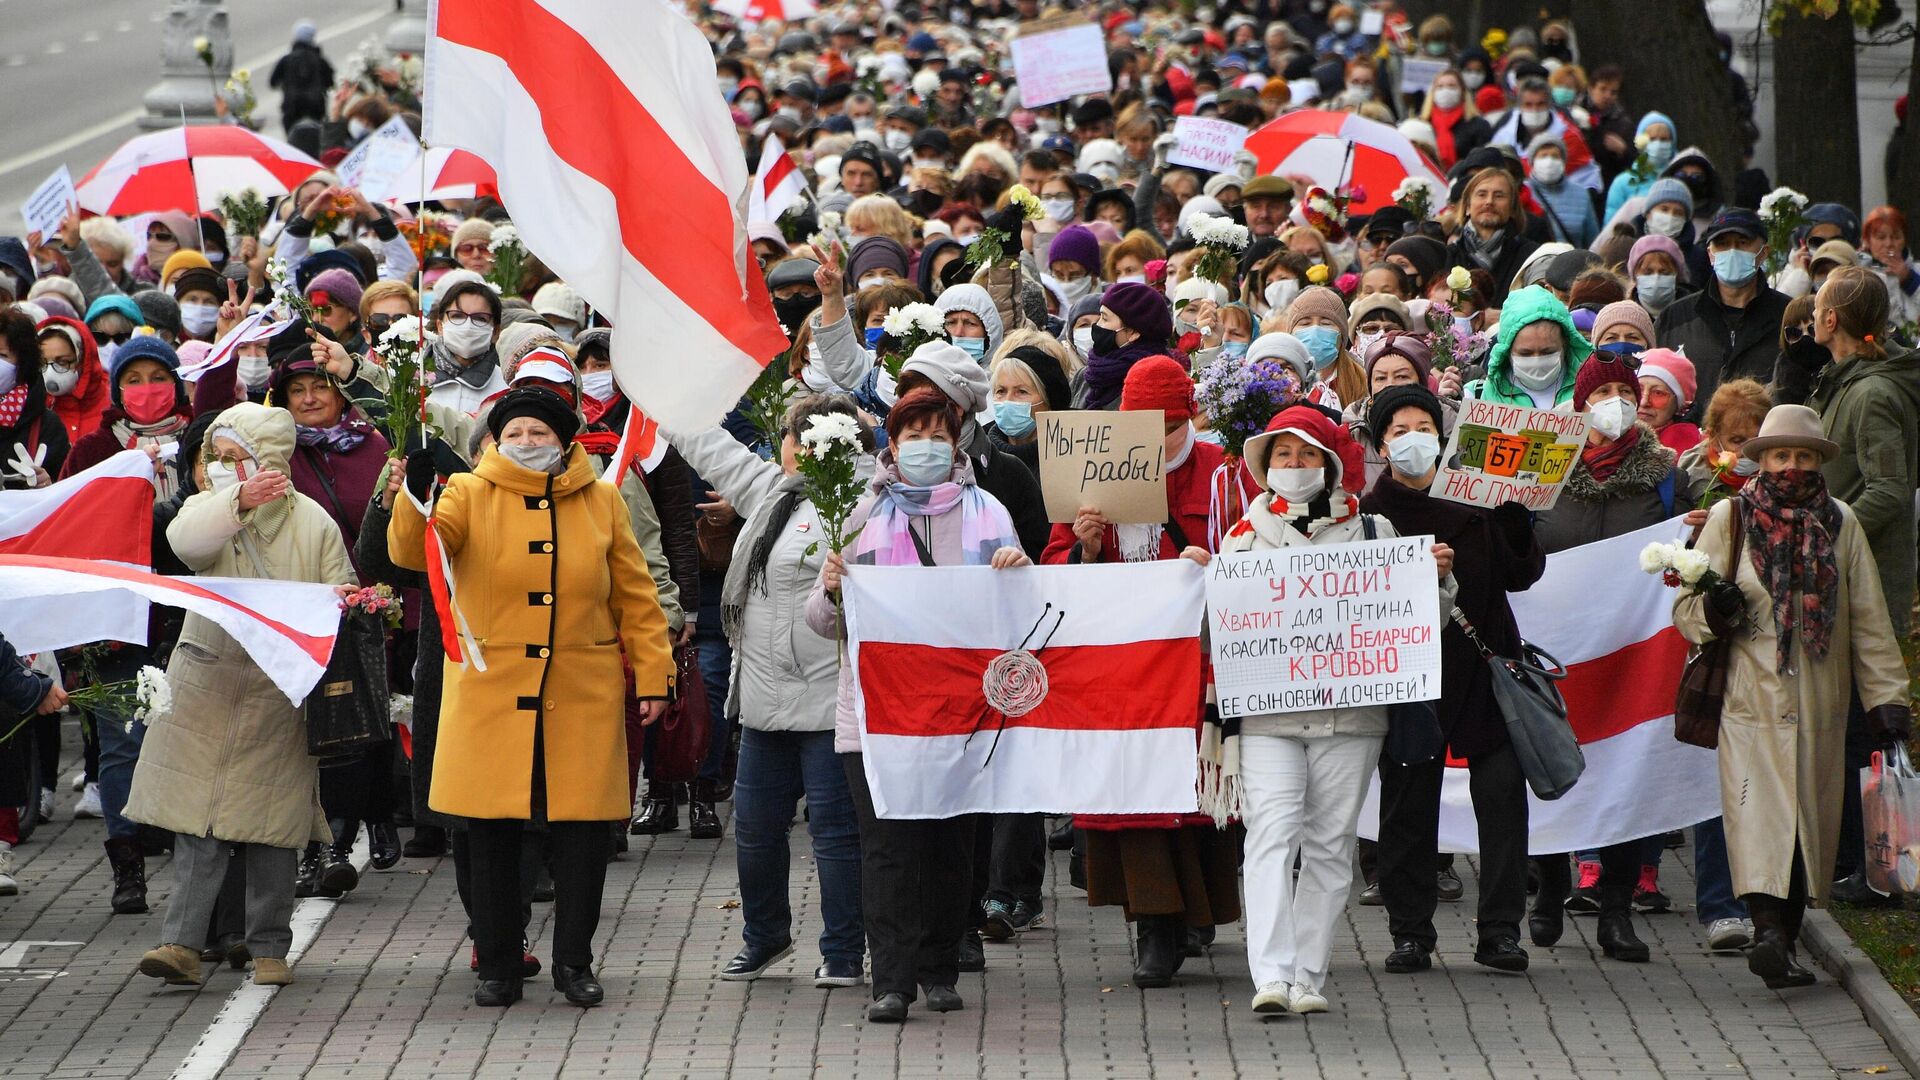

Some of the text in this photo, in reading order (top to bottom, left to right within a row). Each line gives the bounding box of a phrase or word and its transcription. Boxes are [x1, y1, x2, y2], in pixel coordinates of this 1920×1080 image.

[1180, 144, 1234, 166] НАСИЛИ
[1465, 402, 1585, 436] ХВАТИТ КОРМИТЬ
[1465, 438, 1487, 461] RT
[1490, 446, 1521, 468] БТ
[1080, 445, 1163, 493] рабы!
[1543, 458, 1570, 475] ОНТ
[1444, 473, 1483, 501] НАС
[1290, 537, 1425, 574] ПРОМАХНУЛСЯ!
[1290, 632, 1344, 654] ФАСАД
[1289, 647, 1399, 681] КРОВЬЮ
[1222, 697, 1241, 716] ЕЕ
[1336, 673, 1427, 708] ДОЧЕРЕЙ!
